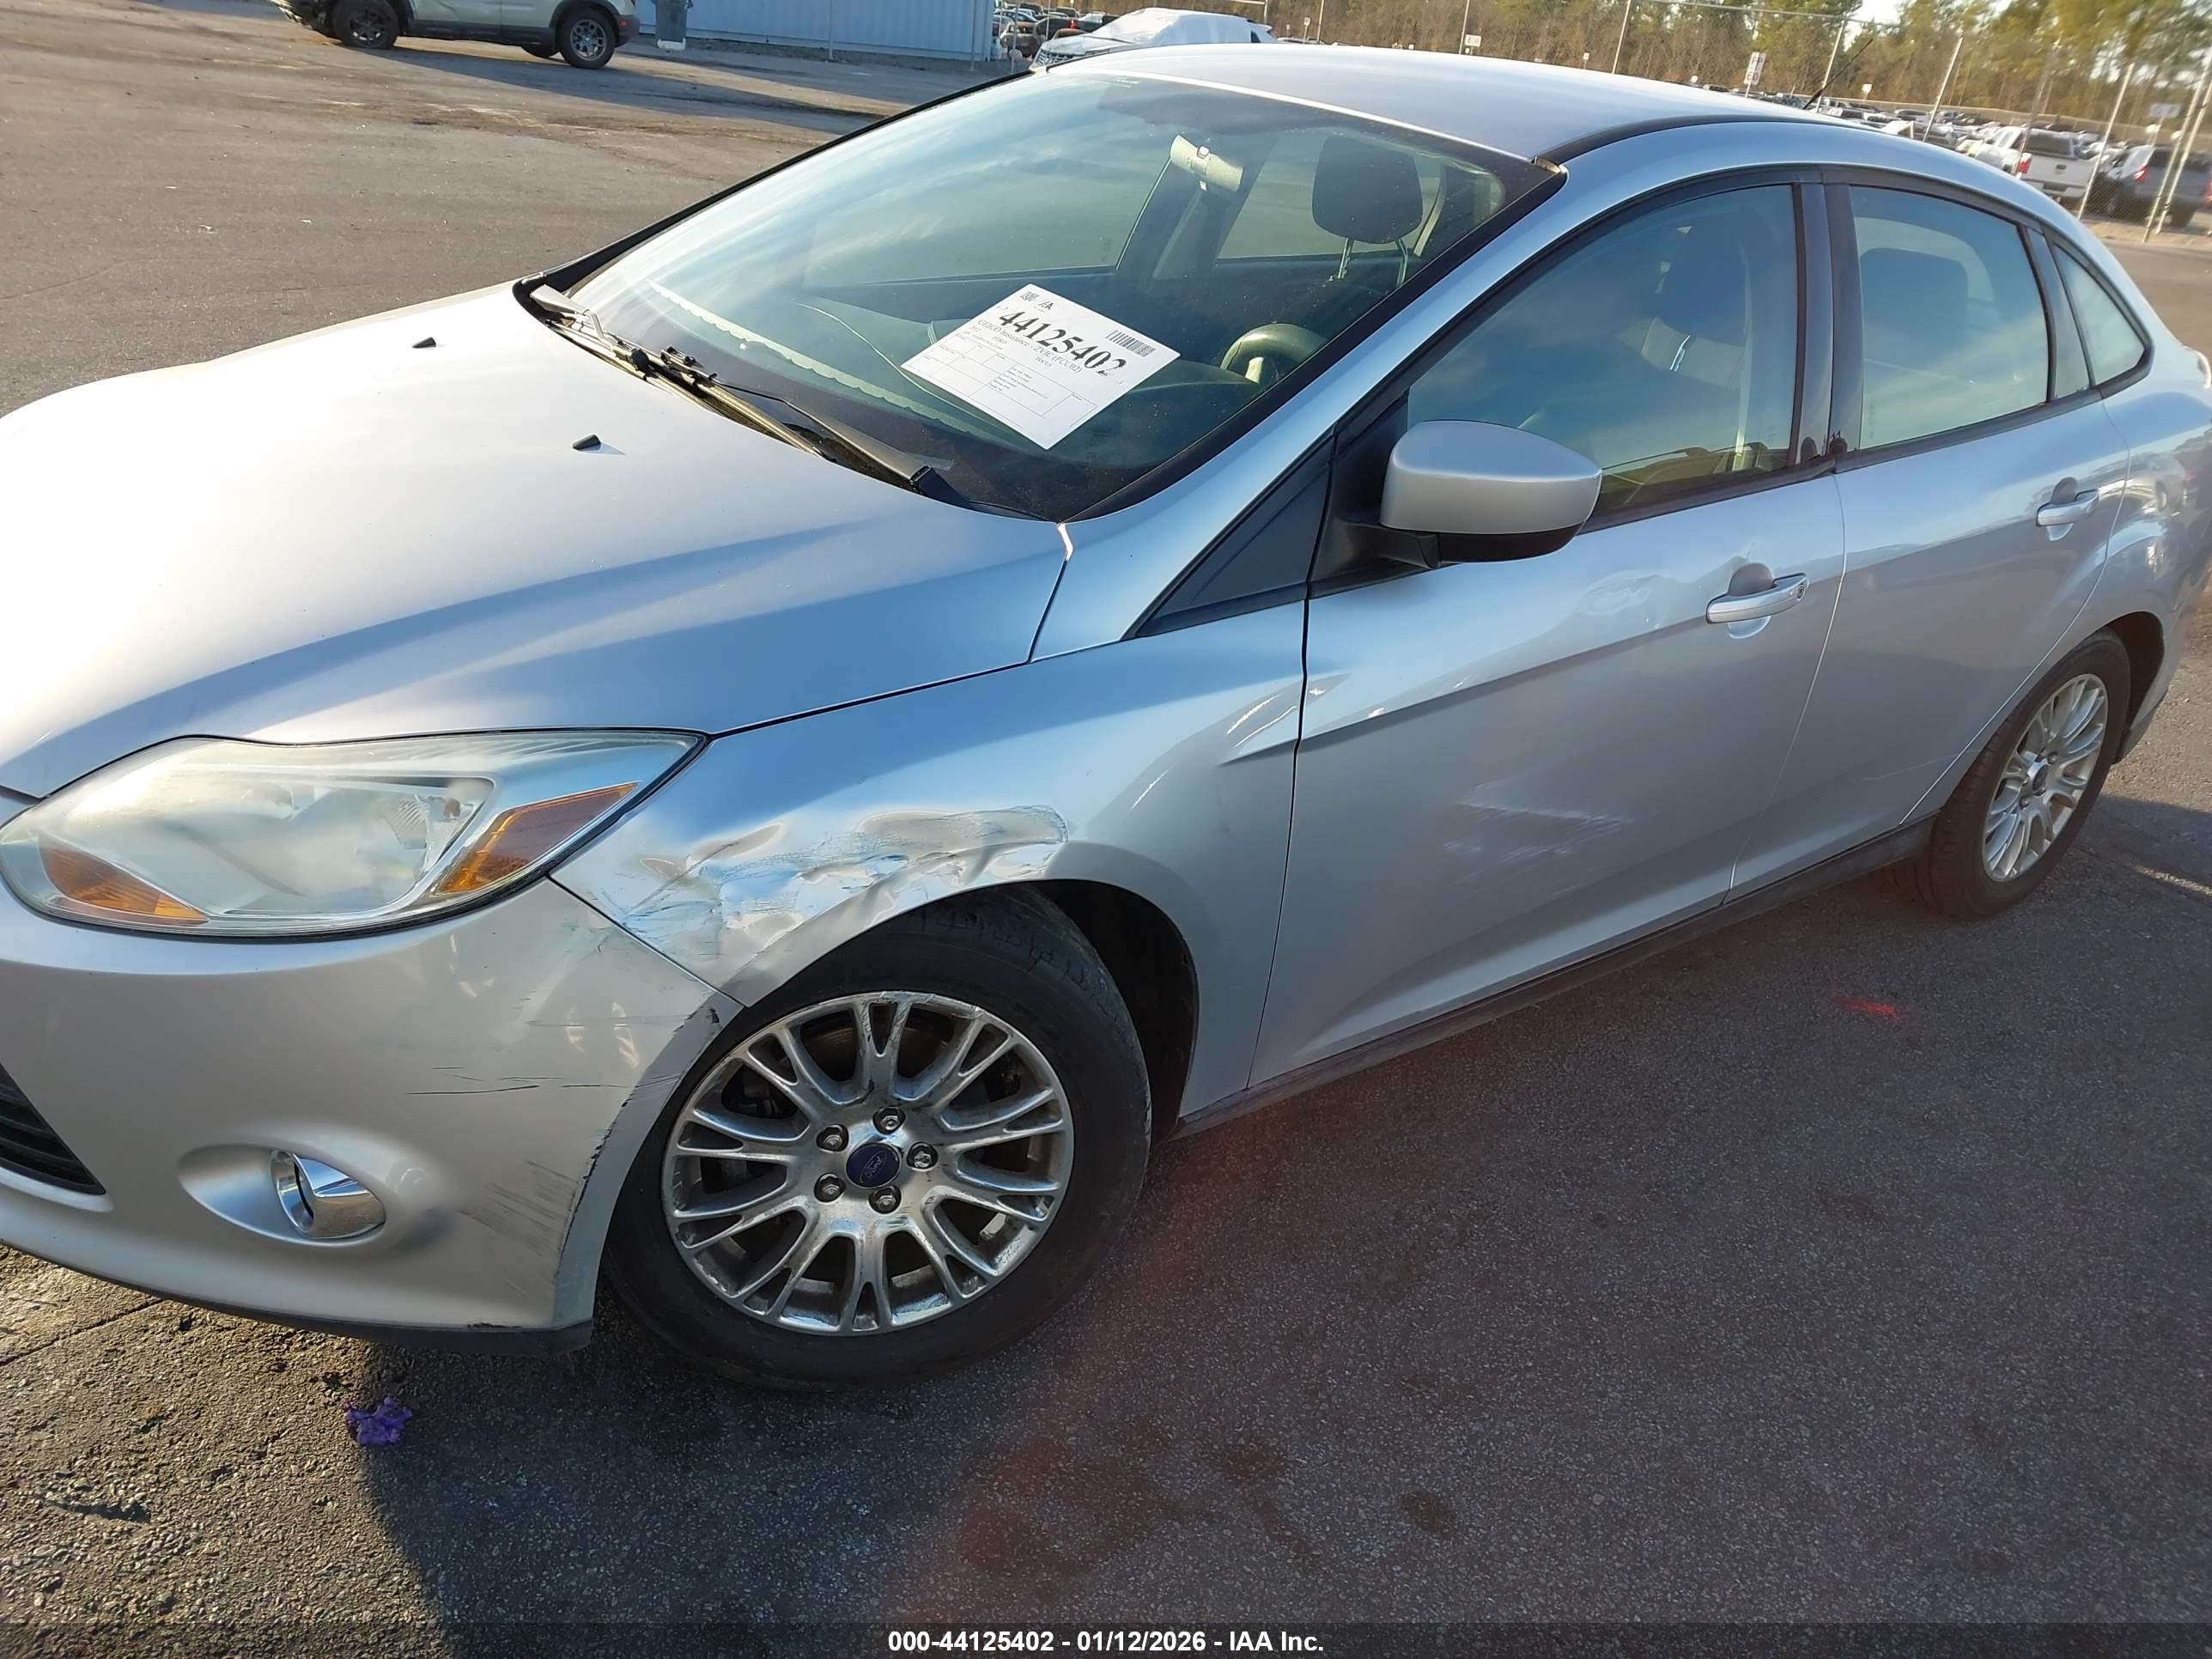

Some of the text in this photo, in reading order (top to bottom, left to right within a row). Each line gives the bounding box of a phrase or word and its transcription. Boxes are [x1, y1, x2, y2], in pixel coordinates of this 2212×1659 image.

[977, 319, 1001, 333] GEICO
[1000, 330, 1030, 348] Insurance
[1000, 311, 1127, 376] 44125402
[865, 1156, 884, 1179] Ford
